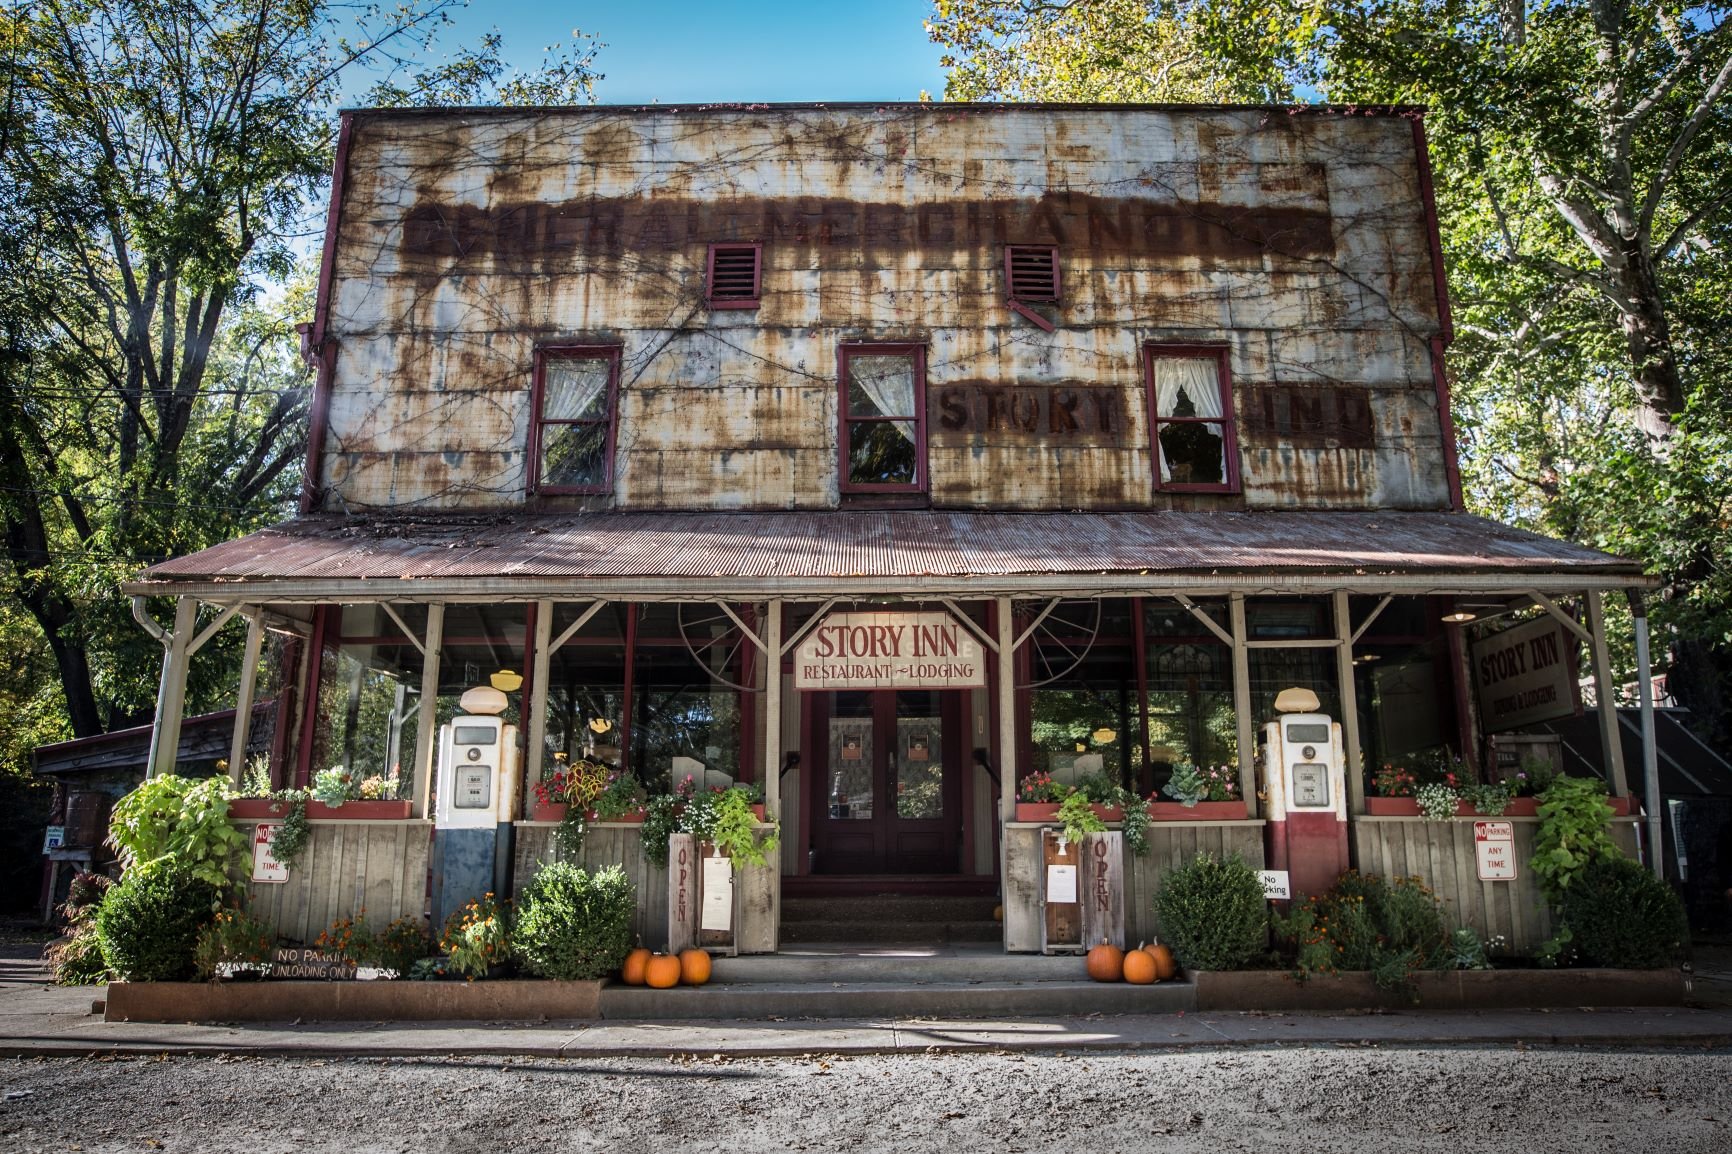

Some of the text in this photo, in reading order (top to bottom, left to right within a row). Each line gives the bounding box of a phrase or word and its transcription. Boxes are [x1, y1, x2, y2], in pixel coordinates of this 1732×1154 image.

[939, 388, 1114, 435] STORY
[815, 625, 905, 658] STORY
[912, 624, 958, 657] INN
[1480, 631, 1560, 686] STORY INN
[804, 663, 975, 680] RESTAURANT LODGING
[257, 828, 268, 839] NO
[1475, 826, 1510, 838] NO PARKING
[262, 862, 280, 870] TIME
[1487, 860, 1505, 868] TIME
[1094, 840, 1109, 911] OPEN
[1265, 876, 1276, 884] No
[678, 848, 687, 921] OPEN
[1264, 886, 1286, 895] rking
[278, 949, 349, 962] NO PARKIN
[272, 965, 356, 979] UNLOADING ONLY
